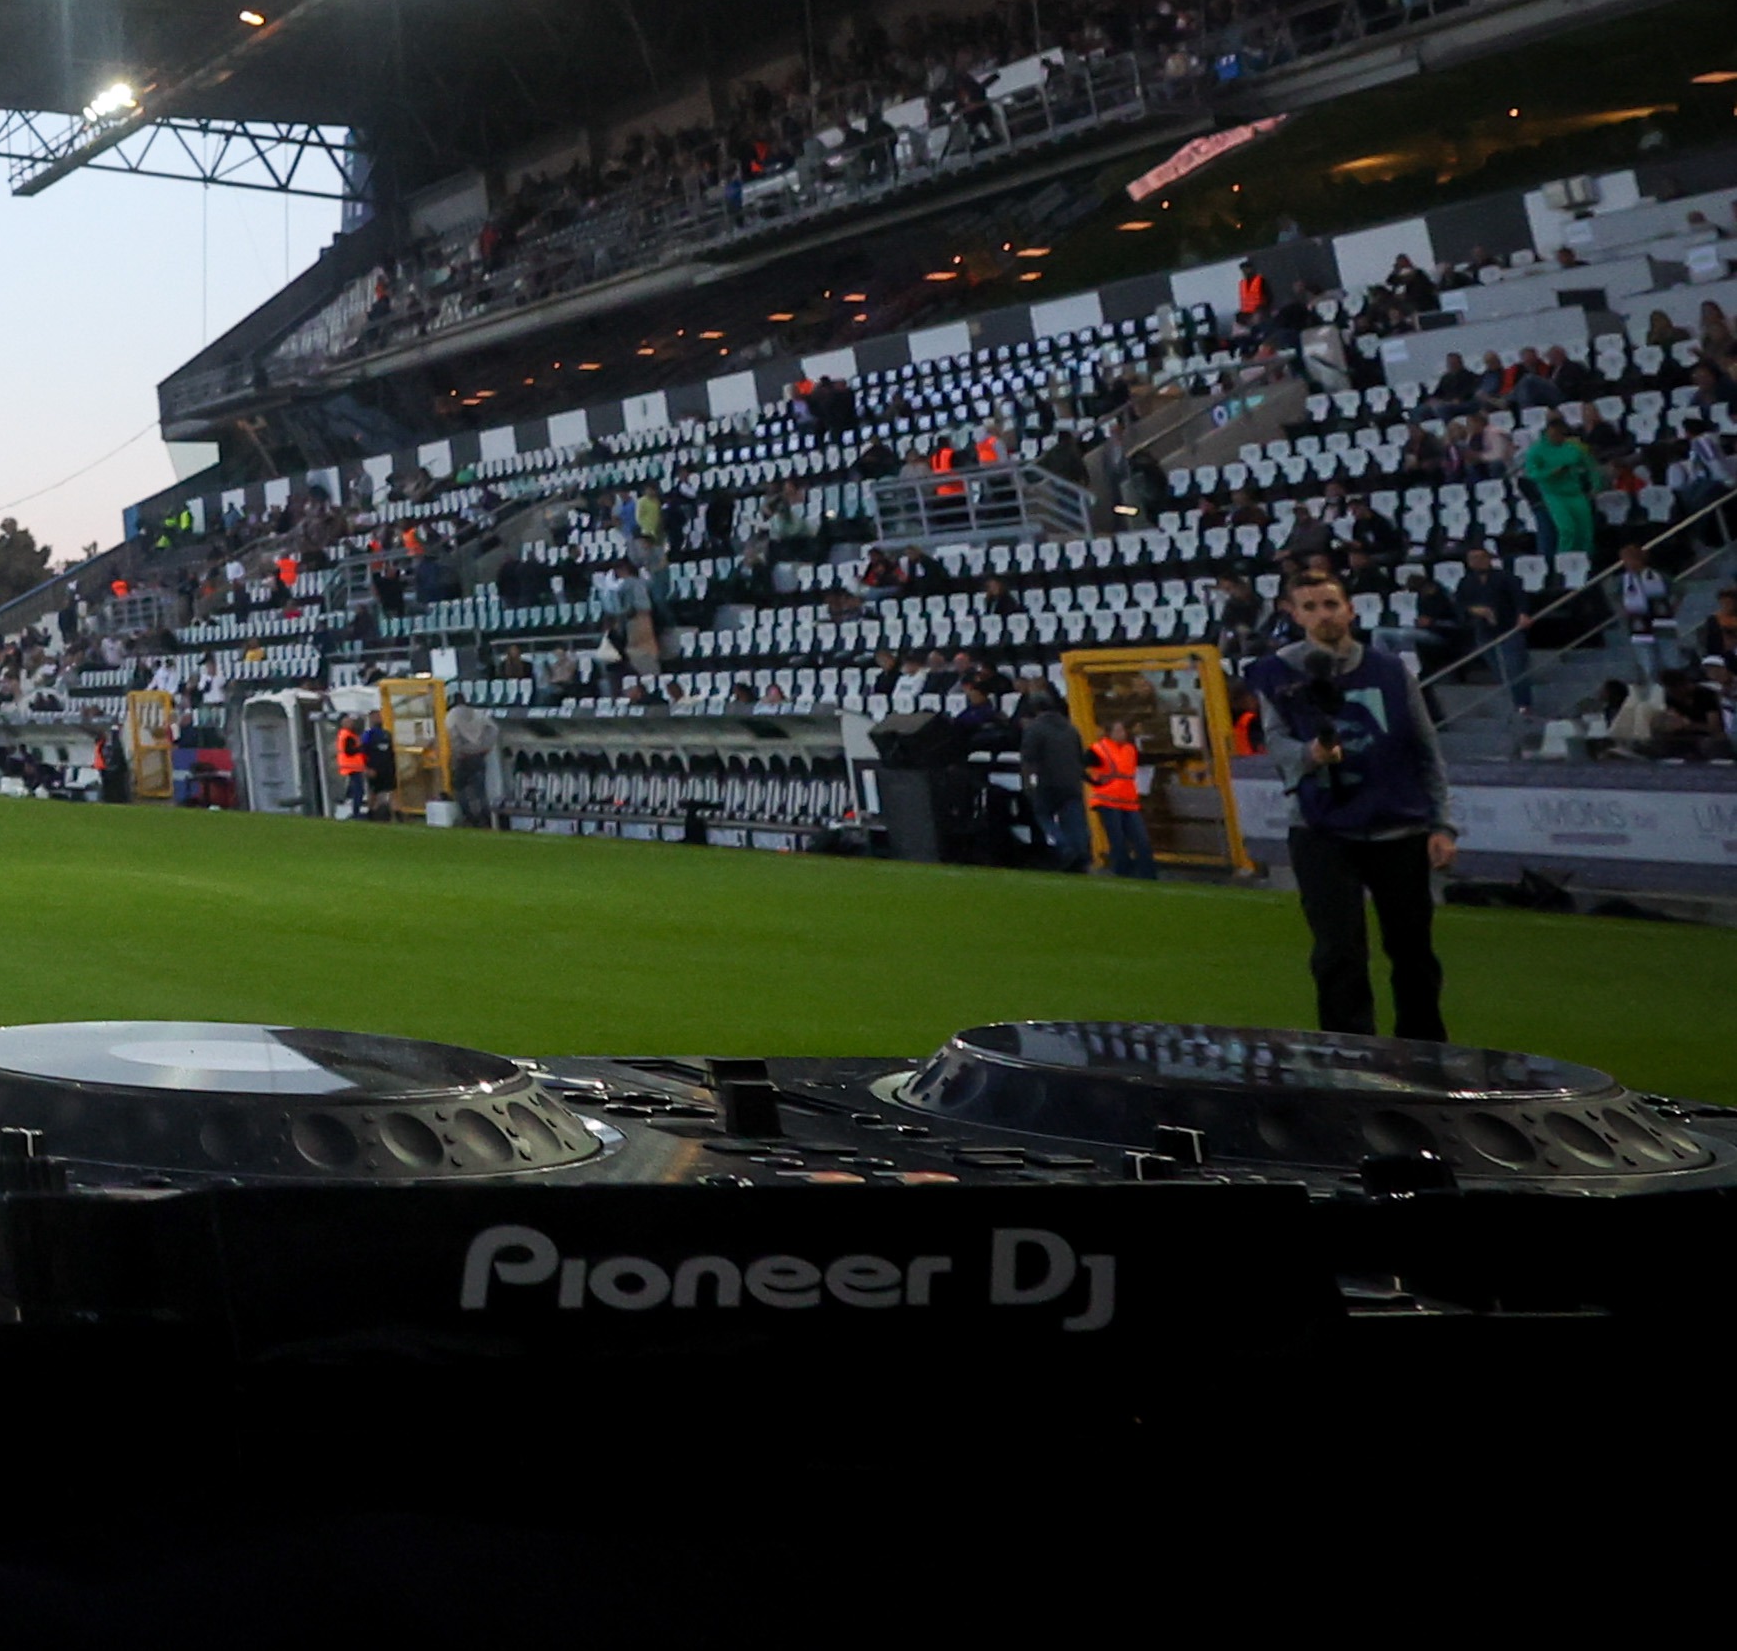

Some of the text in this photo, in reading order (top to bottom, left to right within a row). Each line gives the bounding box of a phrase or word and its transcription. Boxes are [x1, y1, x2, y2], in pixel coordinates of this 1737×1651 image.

[1178, 720, 1193, 744] 3
[461, 1224, 1117, 1332] Pioneer DJ
